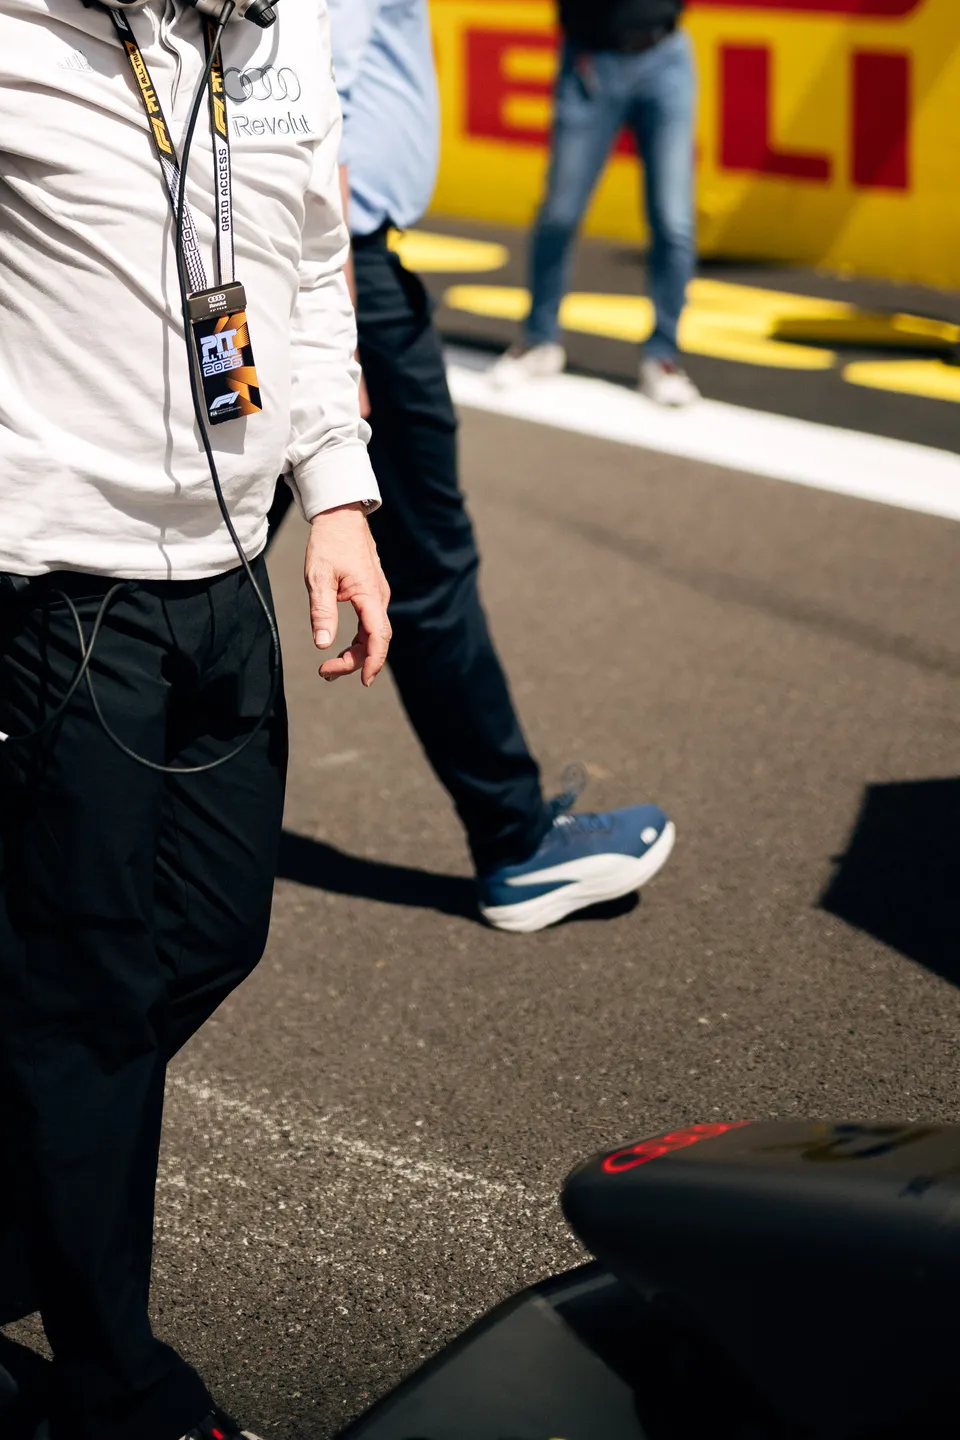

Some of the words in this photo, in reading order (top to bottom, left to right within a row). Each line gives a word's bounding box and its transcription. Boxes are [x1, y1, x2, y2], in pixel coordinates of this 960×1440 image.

[141, 87, 160, 114] PIT
[231, 111, 314, 138] Revolut
[218, 148, 229, 197] ACCESS
[221, 200, 230, 232] GRID
[200, 328, 238, 357] PIT
[202, 353, 218, 365] ALL
